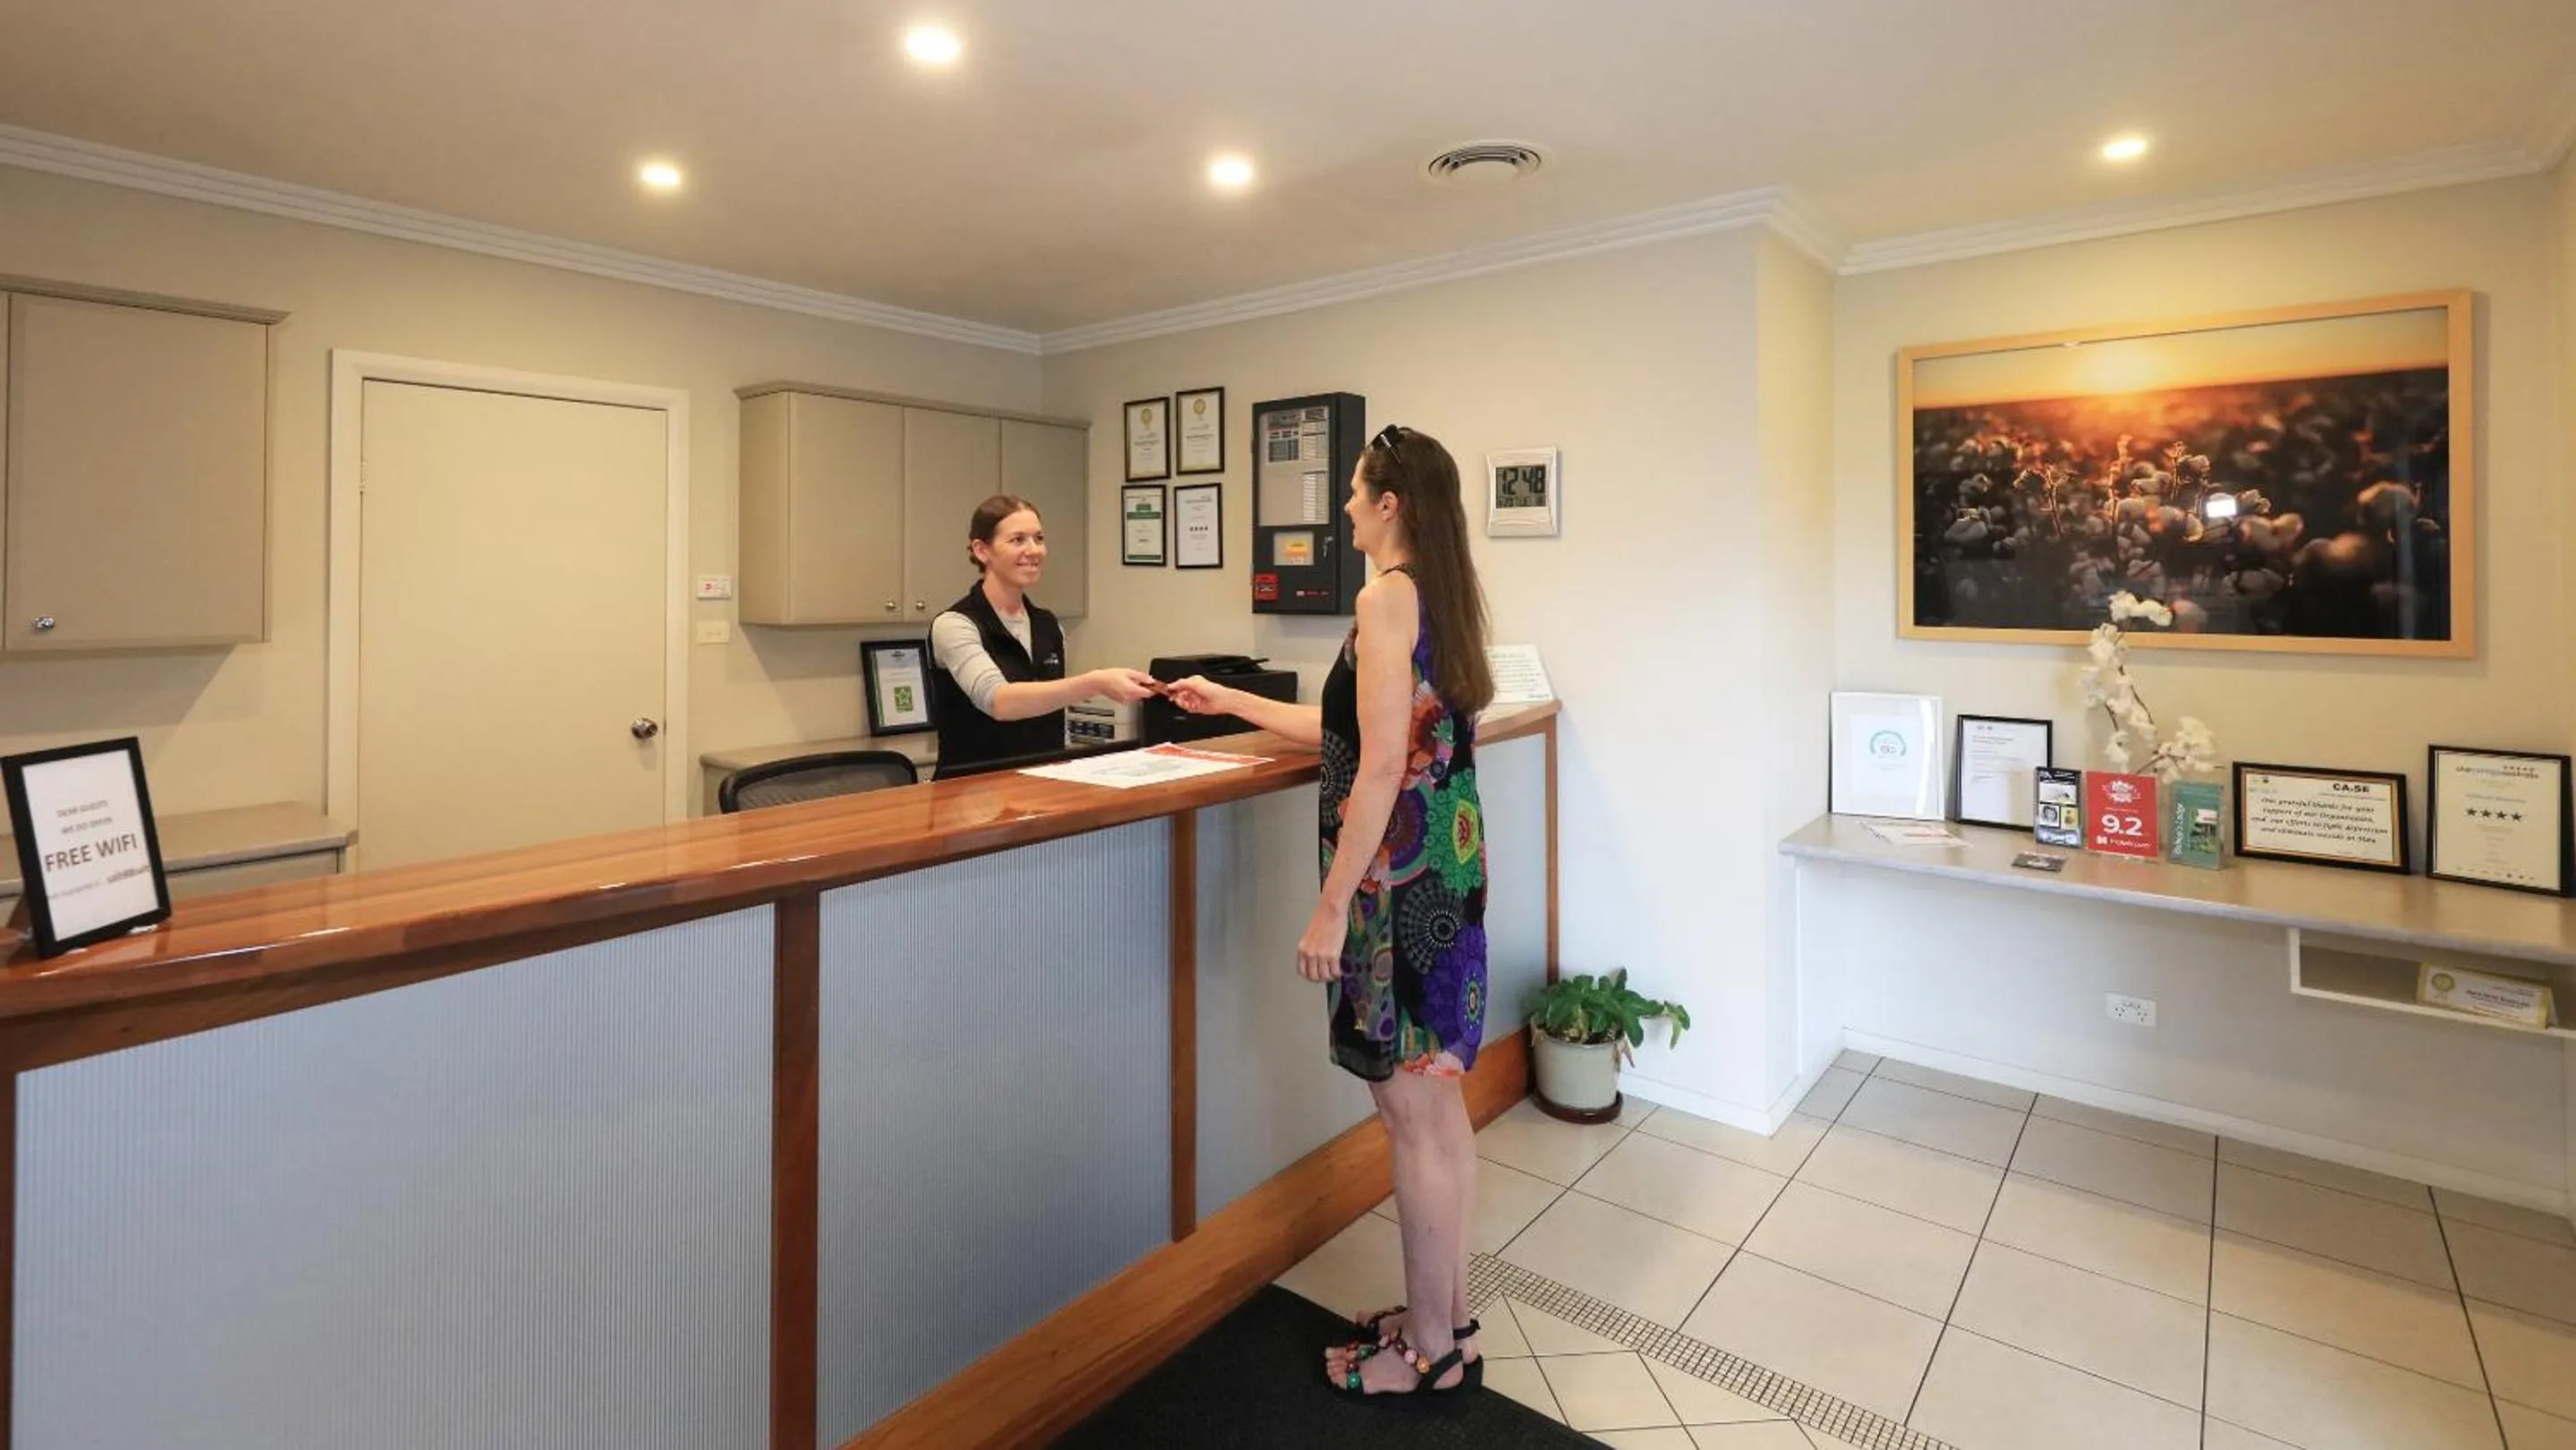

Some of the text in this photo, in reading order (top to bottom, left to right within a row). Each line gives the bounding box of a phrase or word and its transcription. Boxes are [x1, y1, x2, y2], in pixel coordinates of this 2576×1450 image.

[2101, 814, 2143, 836] 9.2
[45, 832, 138, 873] FREE WIFI
